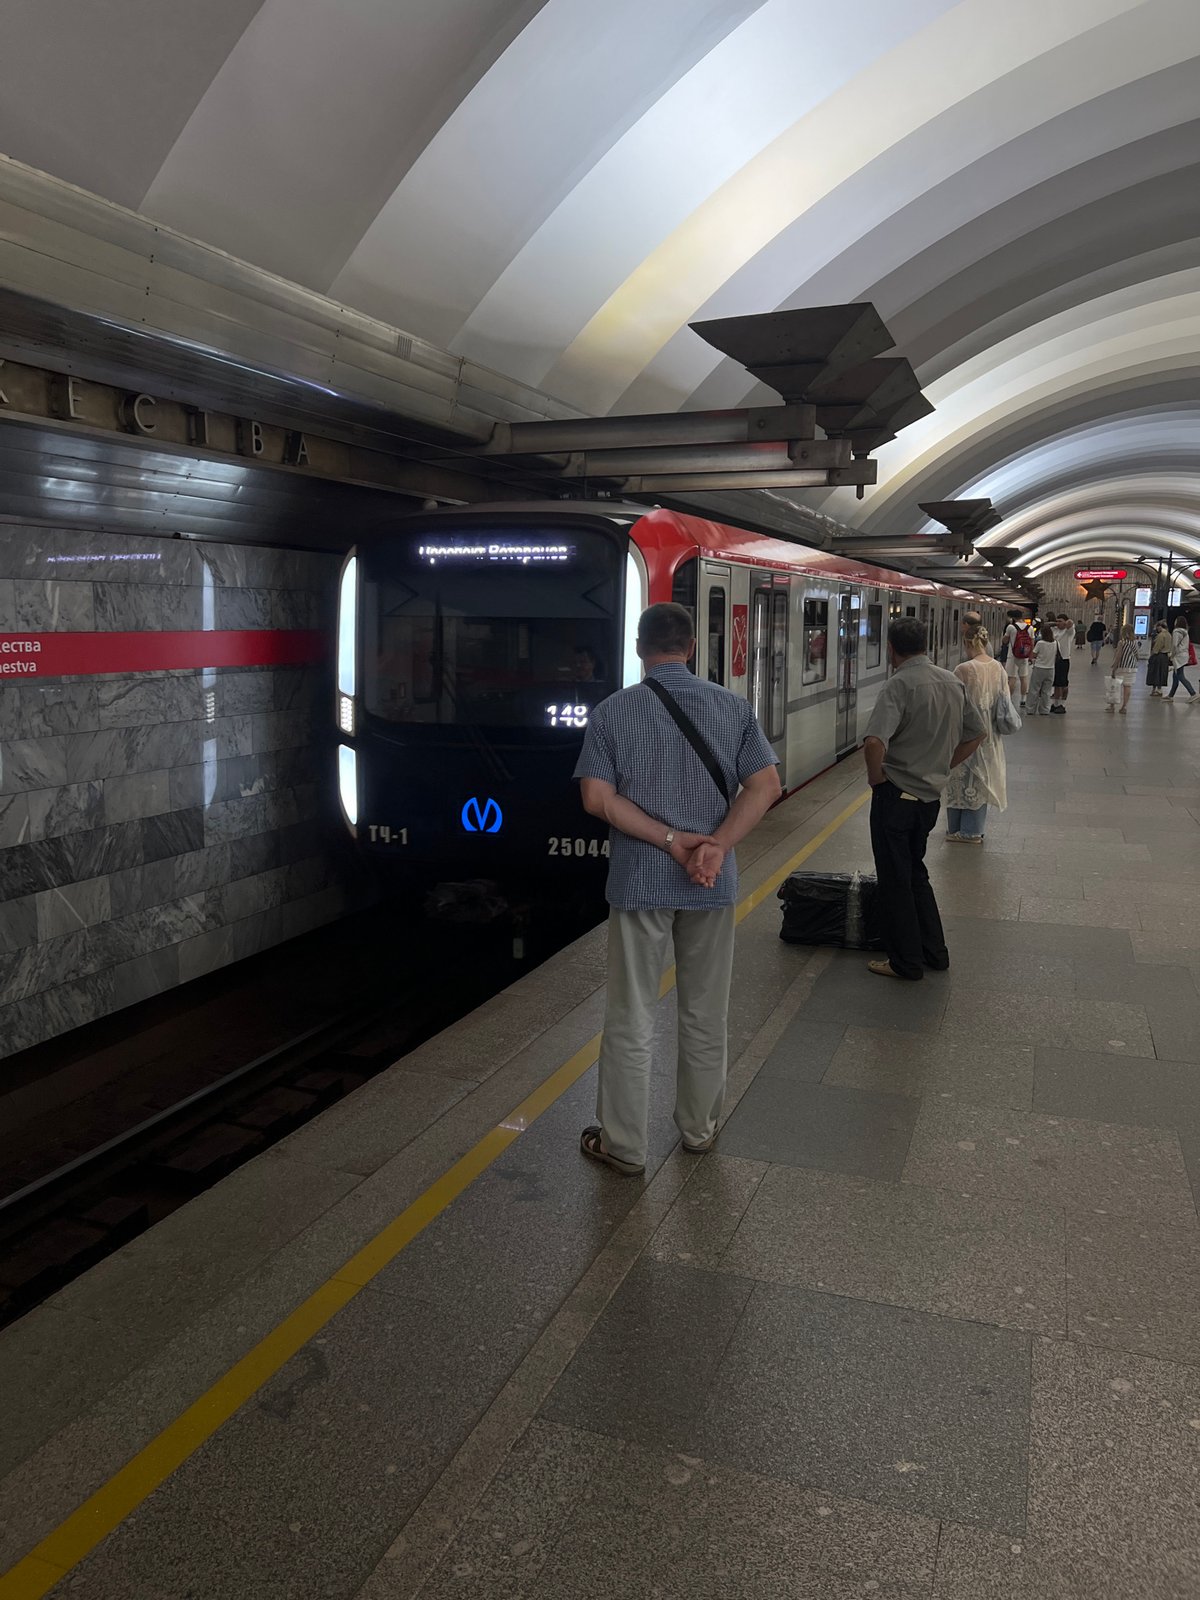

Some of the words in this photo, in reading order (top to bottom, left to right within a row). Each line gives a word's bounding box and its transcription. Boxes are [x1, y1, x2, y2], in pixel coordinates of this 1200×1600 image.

[0, 359, 310, 466] ЕСТВА
[0, 641, 41, 653] ества
[547, 704, 588, 727] 148
[368, 824, 408, 845] ТЧ-1
[548, 837, 610, 858] 25044
